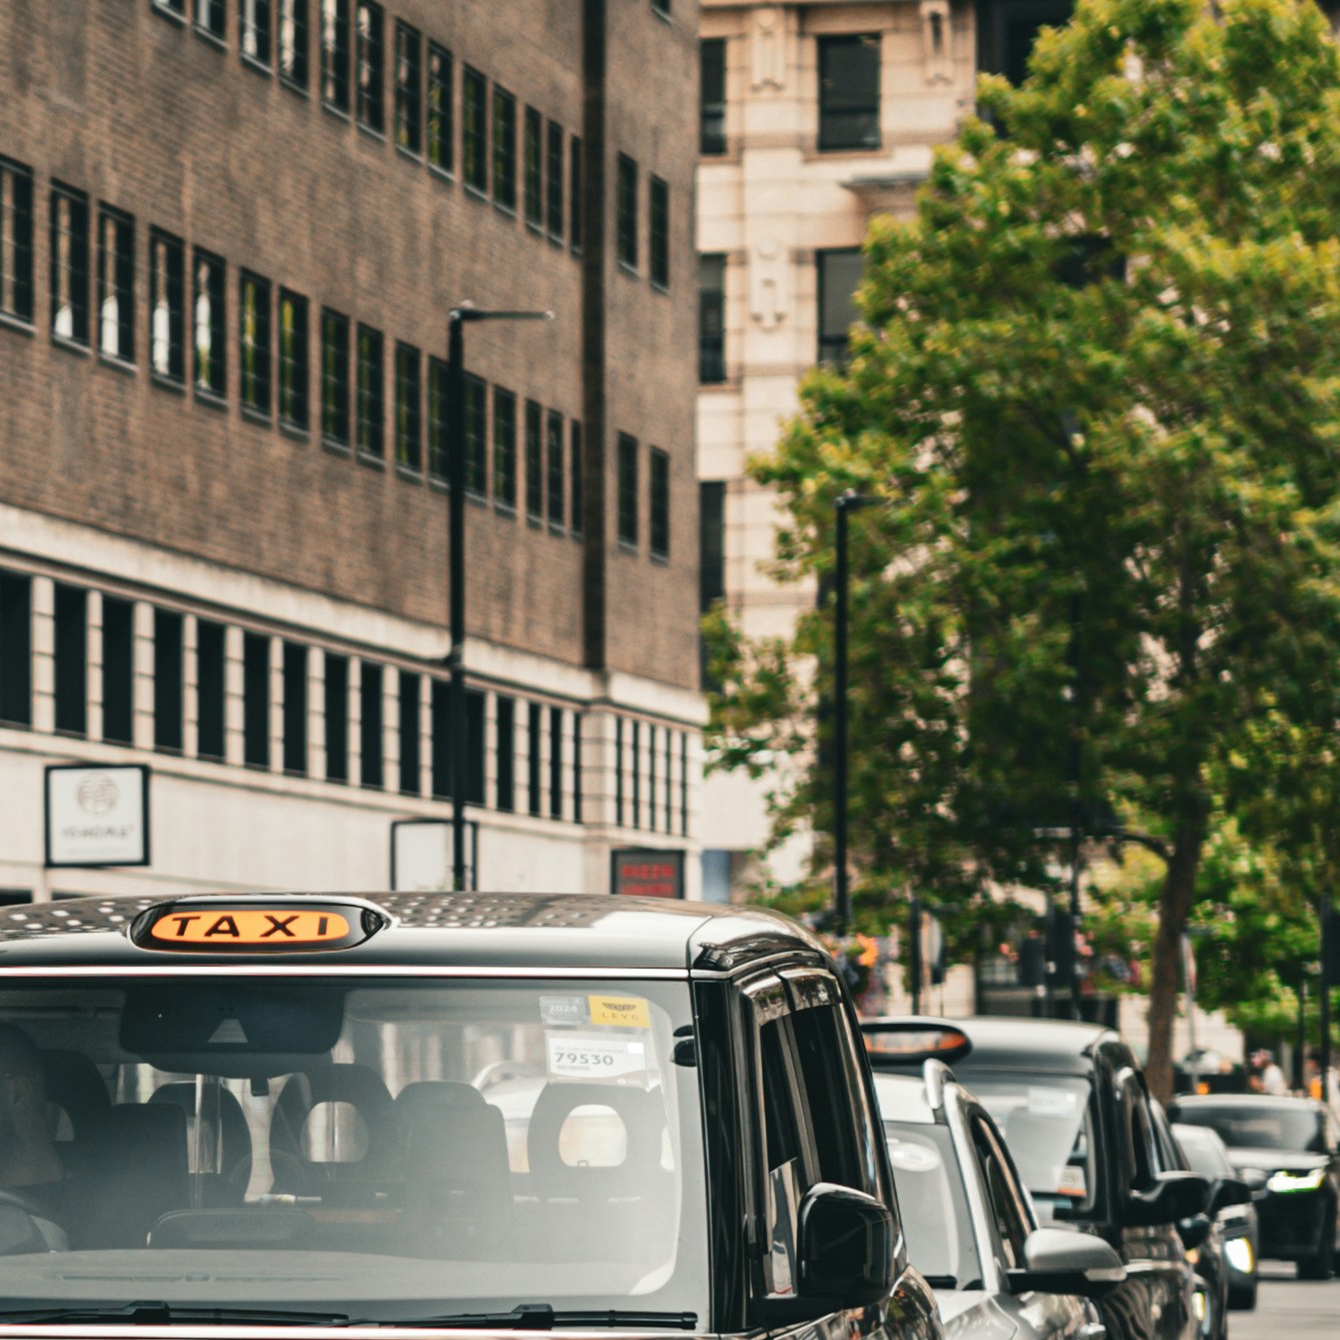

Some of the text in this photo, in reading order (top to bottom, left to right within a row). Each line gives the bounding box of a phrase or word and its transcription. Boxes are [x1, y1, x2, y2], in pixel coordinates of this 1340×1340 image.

[171, 915, 329, 938] TAXI
[602, 1013, 640, 1021] LEVC
[555, 1052, 614, 1065] 79530
